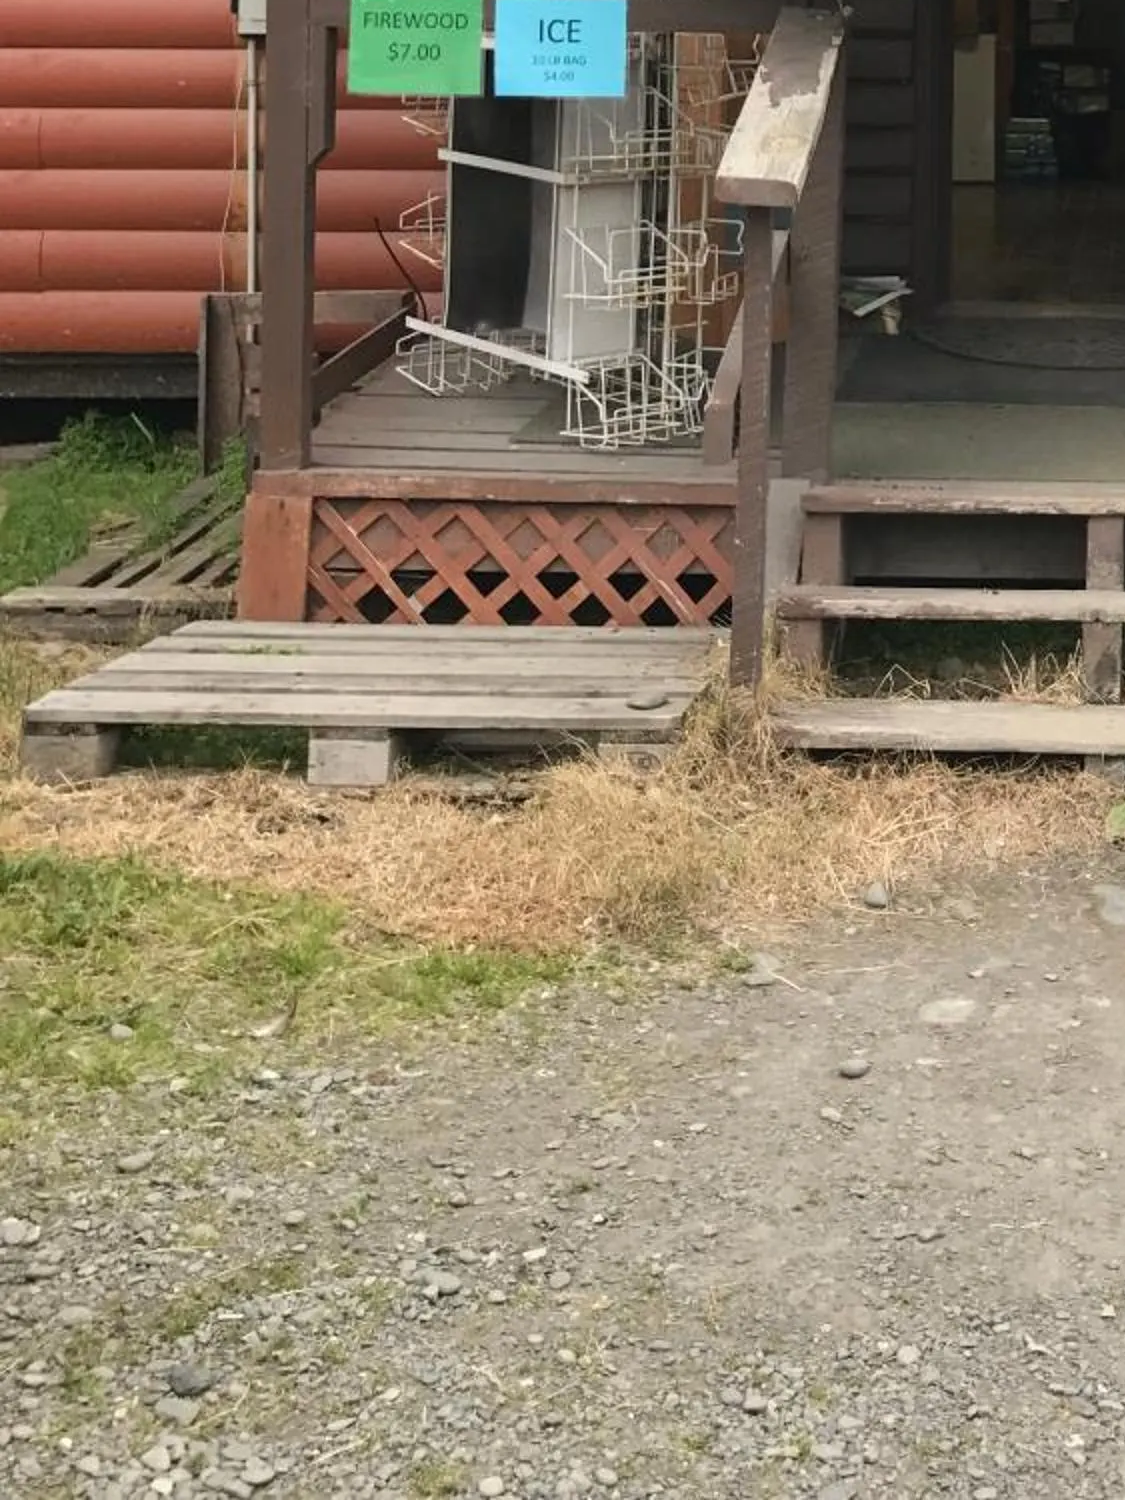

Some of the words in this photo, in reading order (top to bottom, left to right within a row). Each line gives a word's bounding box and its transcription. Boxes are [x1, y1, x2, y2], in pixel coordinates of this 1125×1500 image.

[362, 11, 469, 30] FIREWOOD
[538, 18, 582, 44] ICE
[387, 42, 441, 62] $7.00
